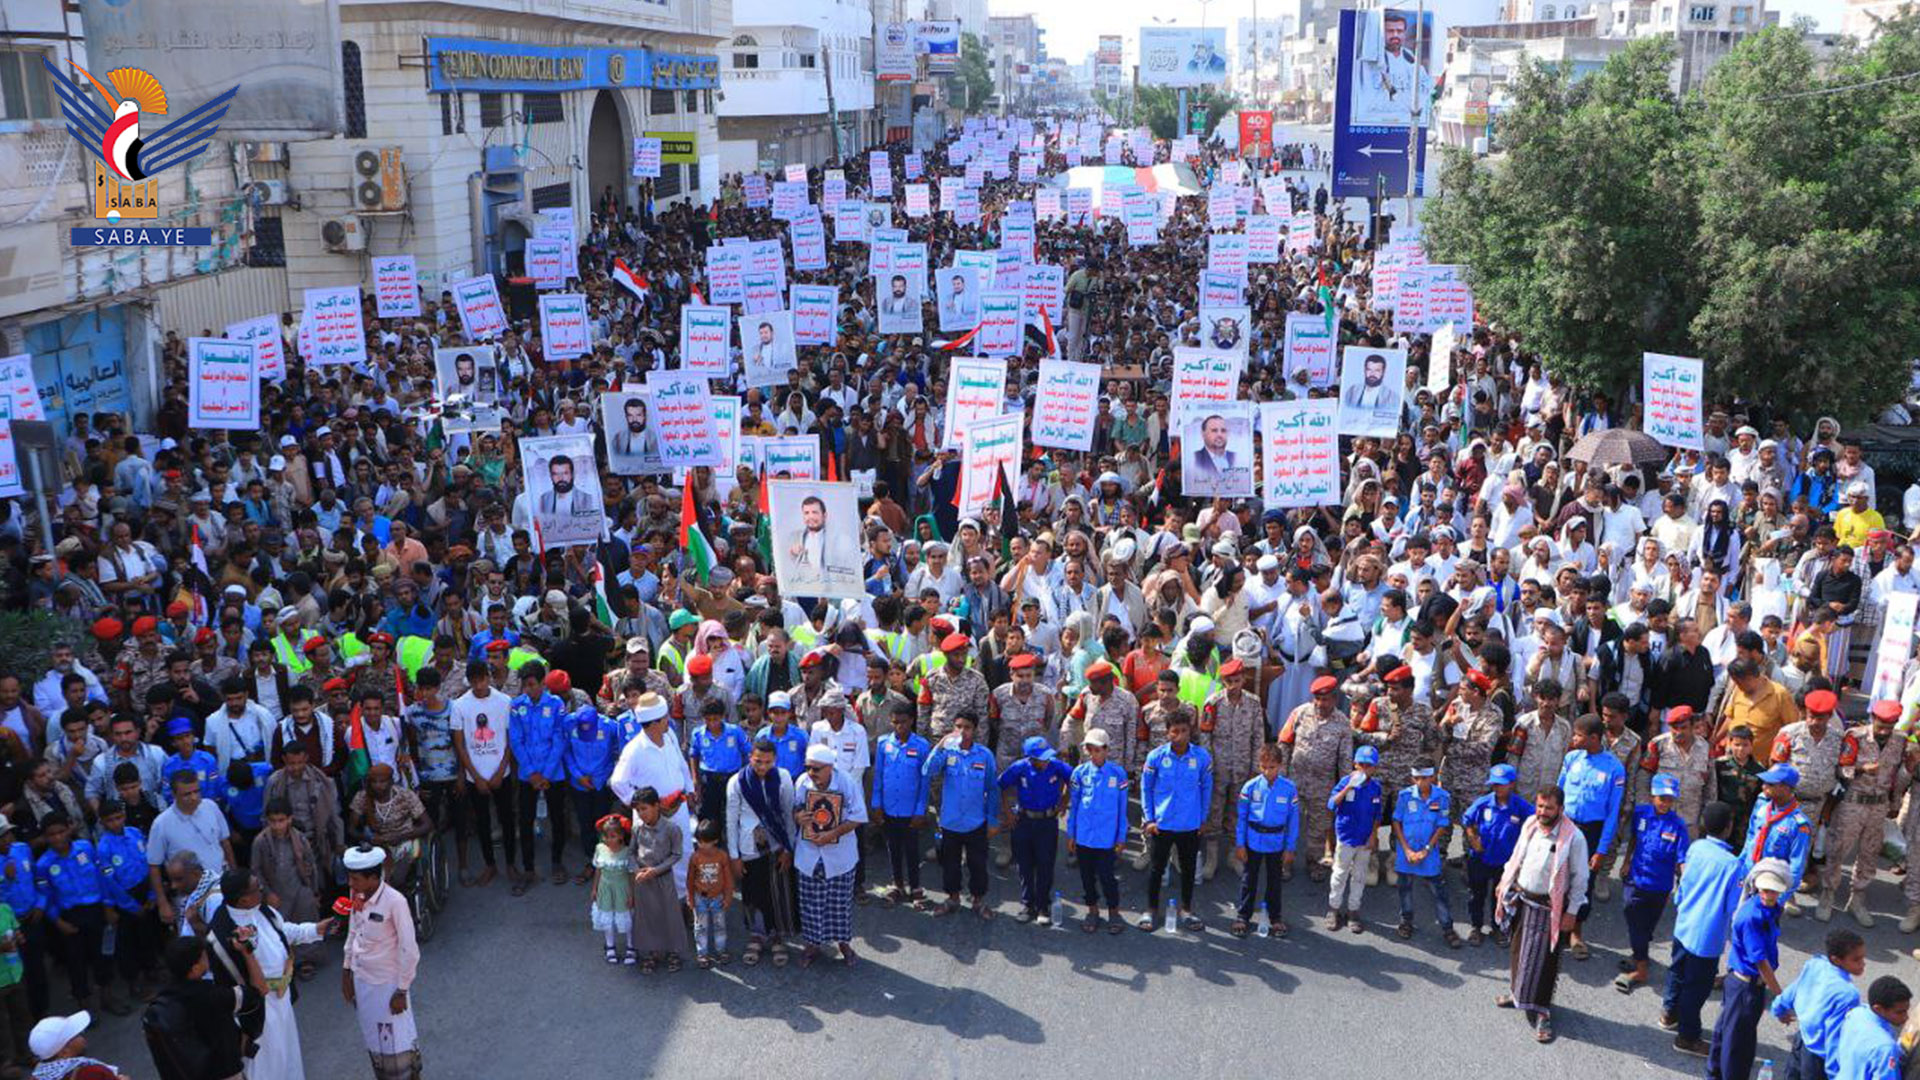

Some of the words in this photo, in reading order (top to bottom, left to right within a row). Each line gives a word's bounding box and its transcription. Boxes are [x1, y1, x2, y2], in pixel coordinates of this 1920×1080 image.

[440, 50, 487, 78] YEMEN
[489, 54, 557, 81] COMMERCIAL
[560, 56, 585, 80] BANK
[1182, 357, 1211, 375] أكبر
[1212, 358, 1232, 372] الله
[1046, 370, 1076, 387] أكبر
[1075, 373, 1093, 386] الله
[656, 381, 682, 400] أكبر
[683, 382, 701, 395] الله
[1273, 410, 1307, 433] أكبر
[1309, 412, 1331, 427] الله
[1273, 481, 1303, 499] للإسلام
[1306, 479, 1332, 498] النصر
